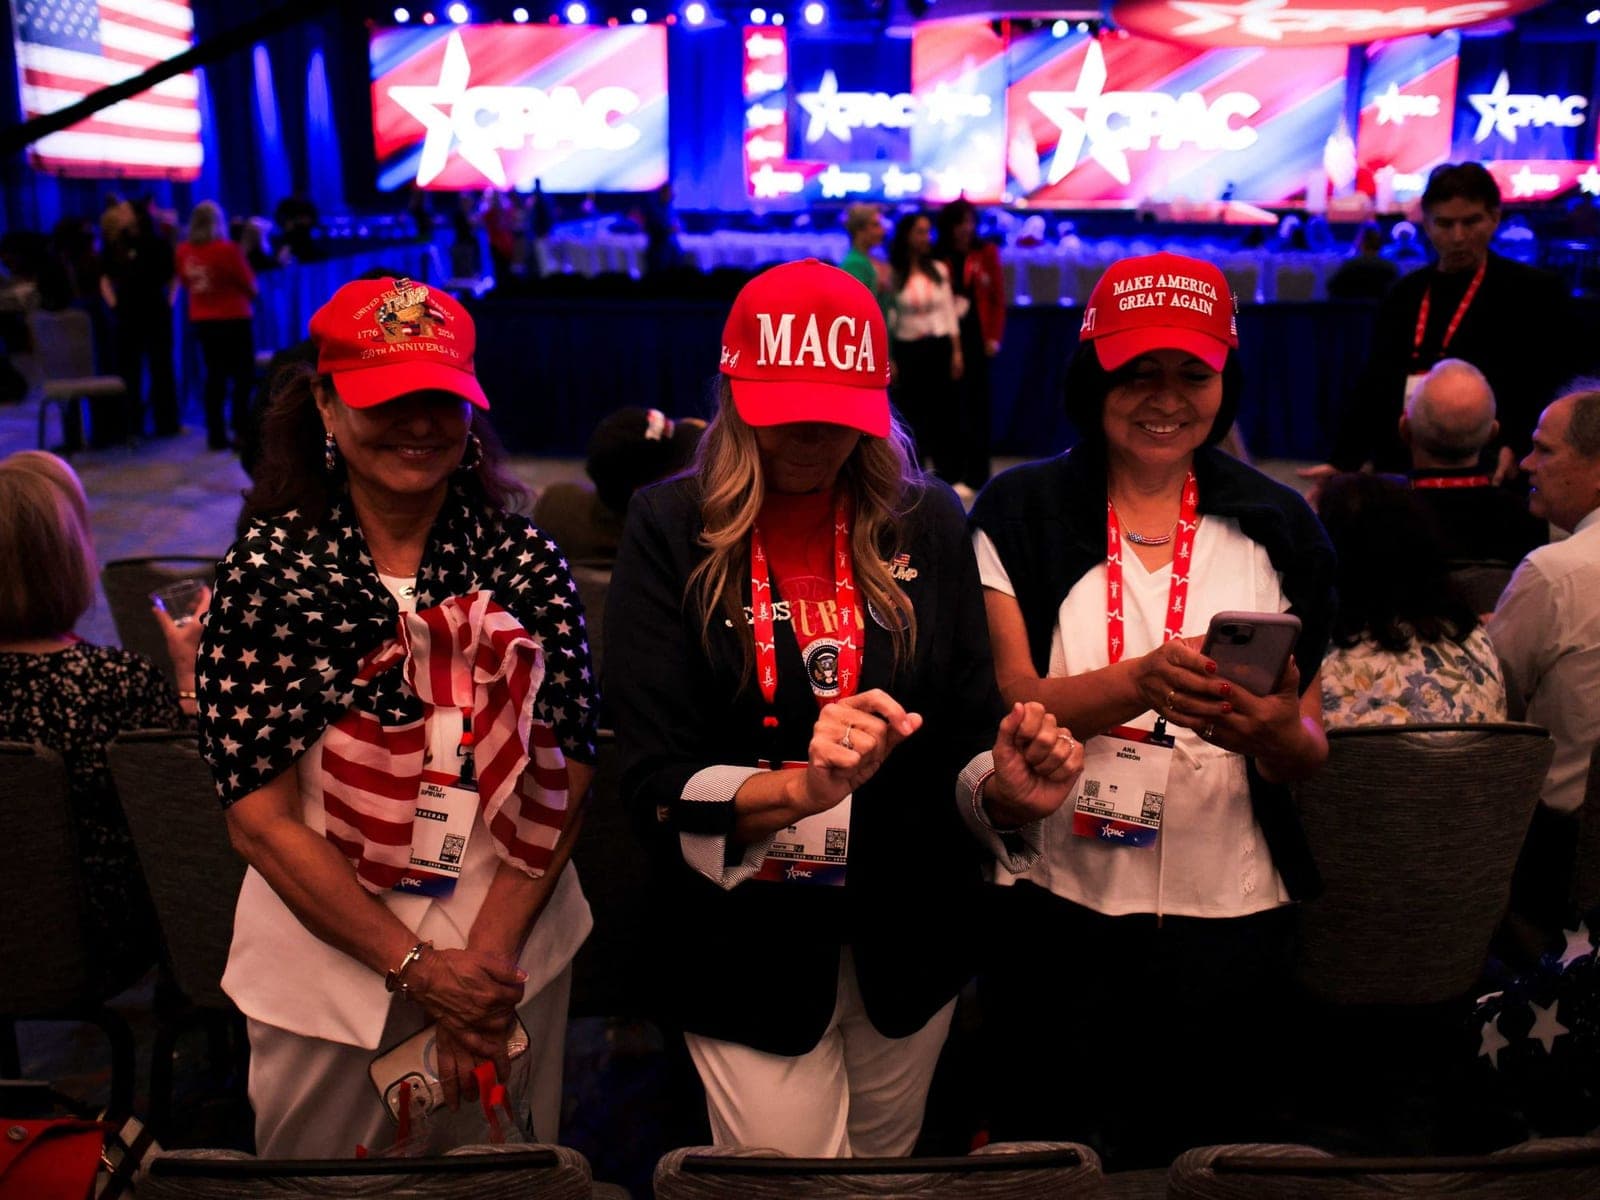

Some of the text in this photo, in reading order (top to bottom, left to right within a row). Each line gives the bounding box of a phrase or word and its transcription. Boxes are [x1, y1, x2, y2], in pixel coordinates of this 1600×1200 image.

[462, 86, 641, 151] CPAC
[1102, 90, 1261, 151] CPAC
[1503, 94, 1589, 127] CPAC
[384, 286, 429, 312] TRUMP
[1113, 274, 1218, 301] MAKE AMERICA
[353, 297, 380, 320] UNITED
[1119, 292, 1213, 316] GREAT AGAIN
[357, 328, 379, 340] 1776
[756, 313, 876, 372] MAGA
[1122, 746, 1136, 754] ANA
